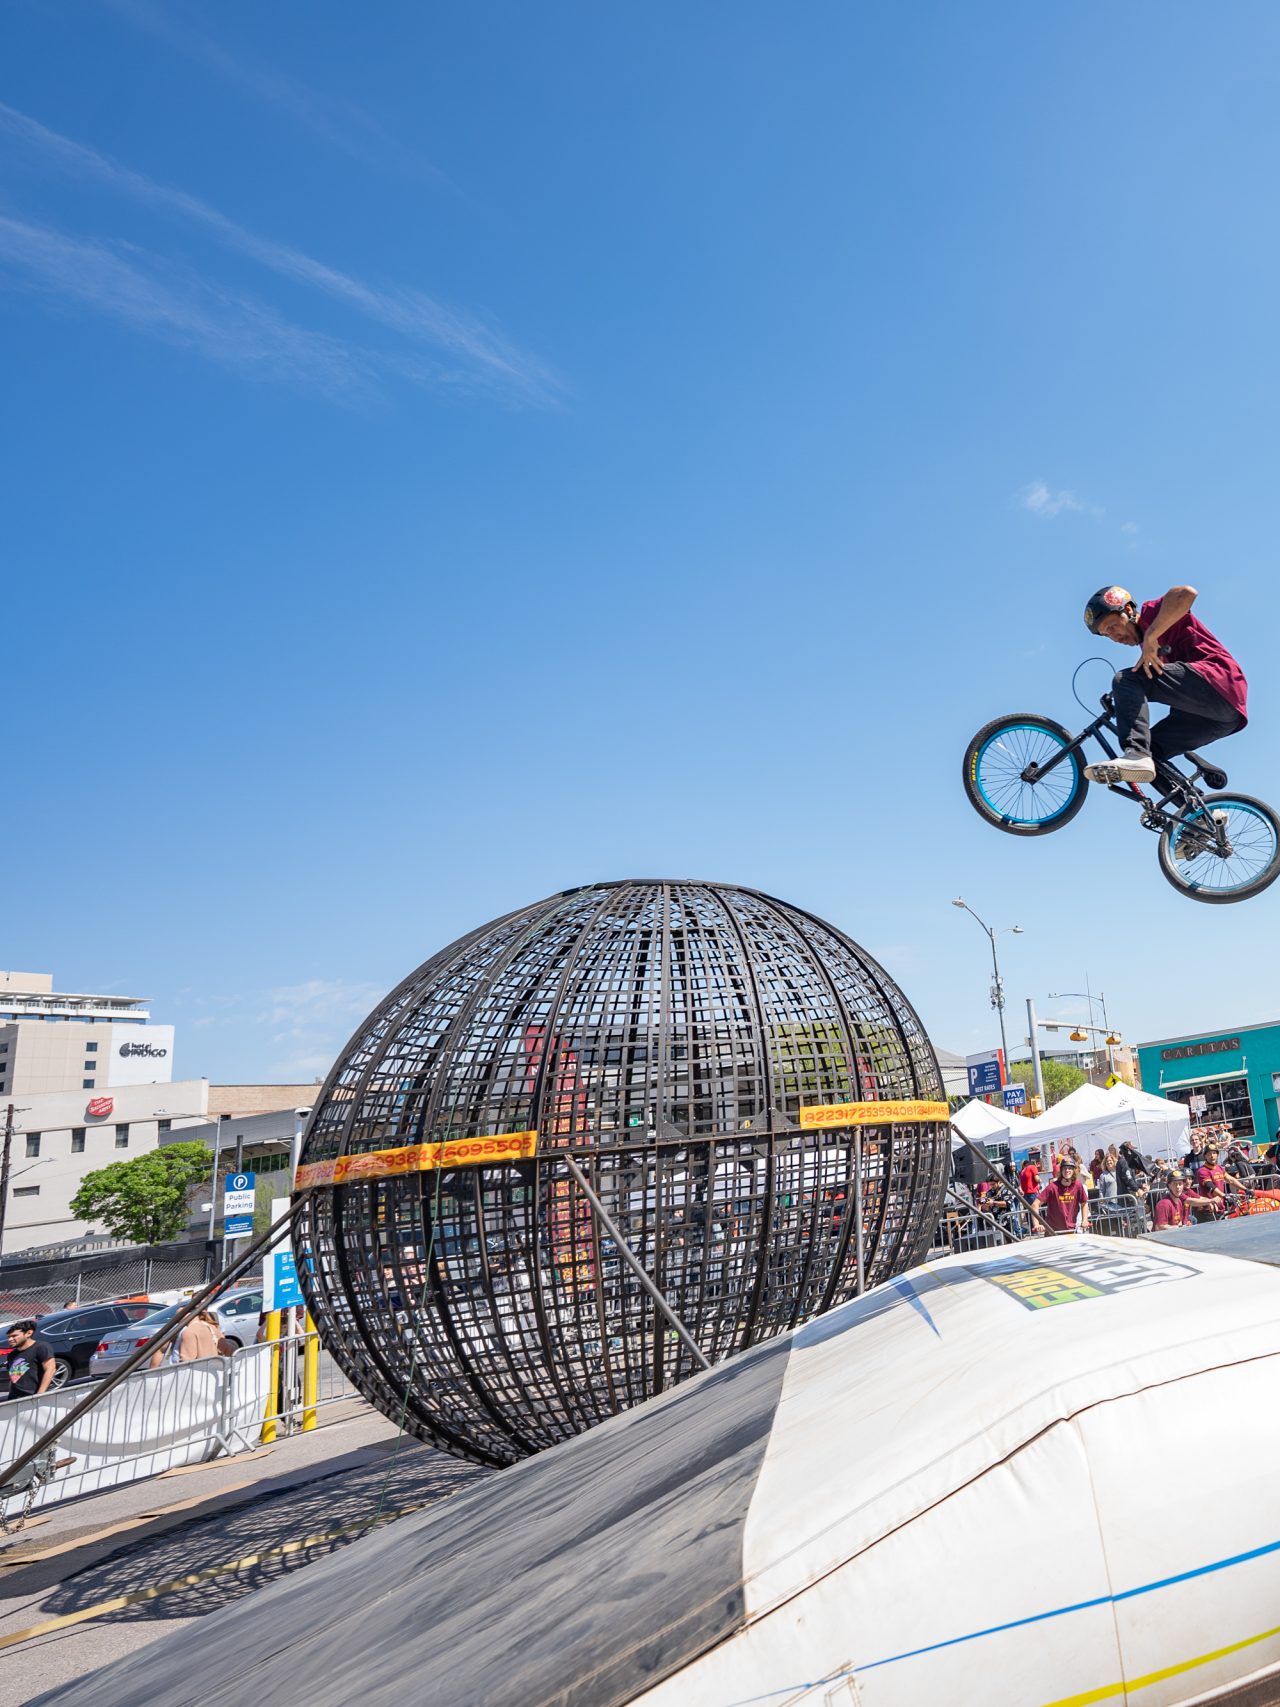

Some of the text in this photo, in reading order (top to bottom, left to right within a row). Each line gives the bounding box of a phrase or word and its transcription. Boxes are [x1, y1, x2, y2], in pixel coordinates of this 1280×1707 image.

[130, 1048, 168, 1058] INDIGO
[1162, 1039, 1240, 1060] CARITAS
[1006, 1090, 1021, 1098] PAY
[1006, 1097, 1024, 1105] HERE
[98, 1104, 112, 1113] ARMY
[229, 1193, 251, 1201] Public
[226, 1202, 253, 1210] Parking
